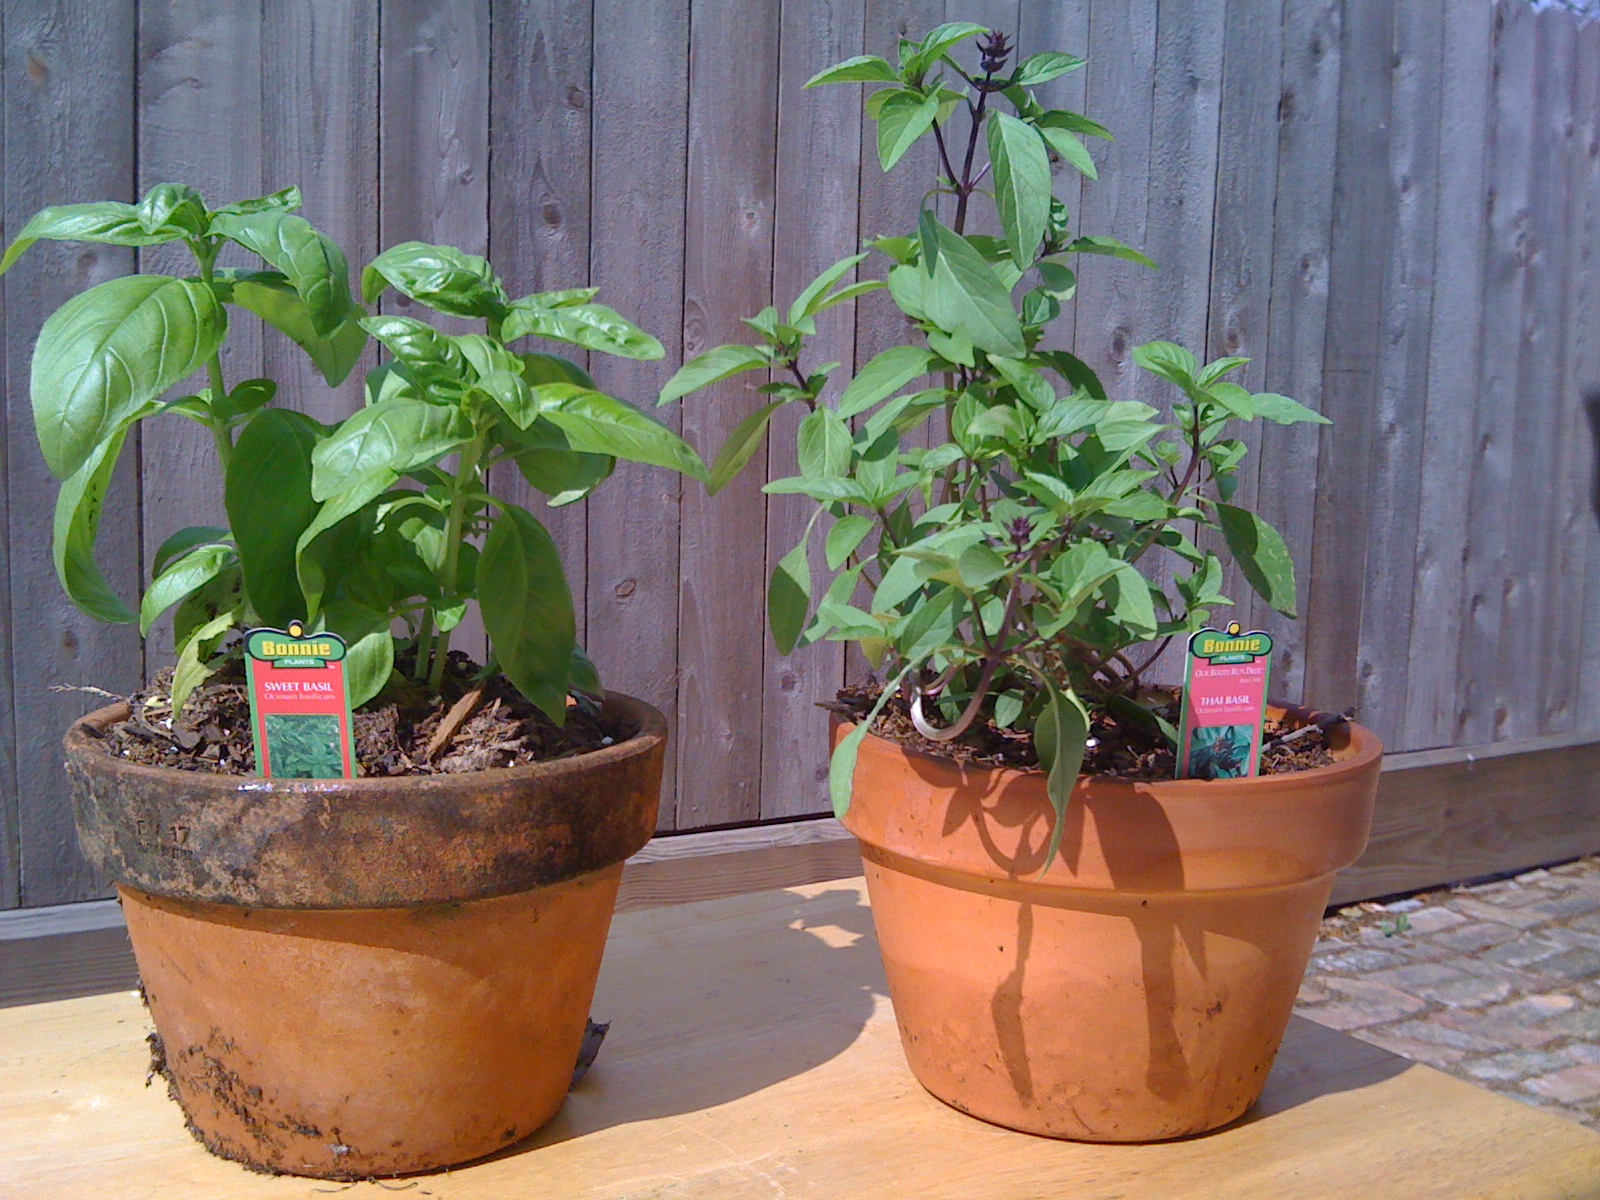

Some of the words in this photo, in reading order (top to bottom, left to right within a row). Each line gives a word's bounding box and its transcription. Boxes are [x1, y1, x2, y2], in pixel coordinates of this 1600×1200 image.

[262, 640, 331, 656] Bonnie
[1203, 638, 1261, 654] Bonnie
[264, 682, 299, 692] SWEET
[303, 682, 333, 692] BASIL
[1201, 697, 1223, 706] THAI
[1225, 695, 1250, 704] BASIL
